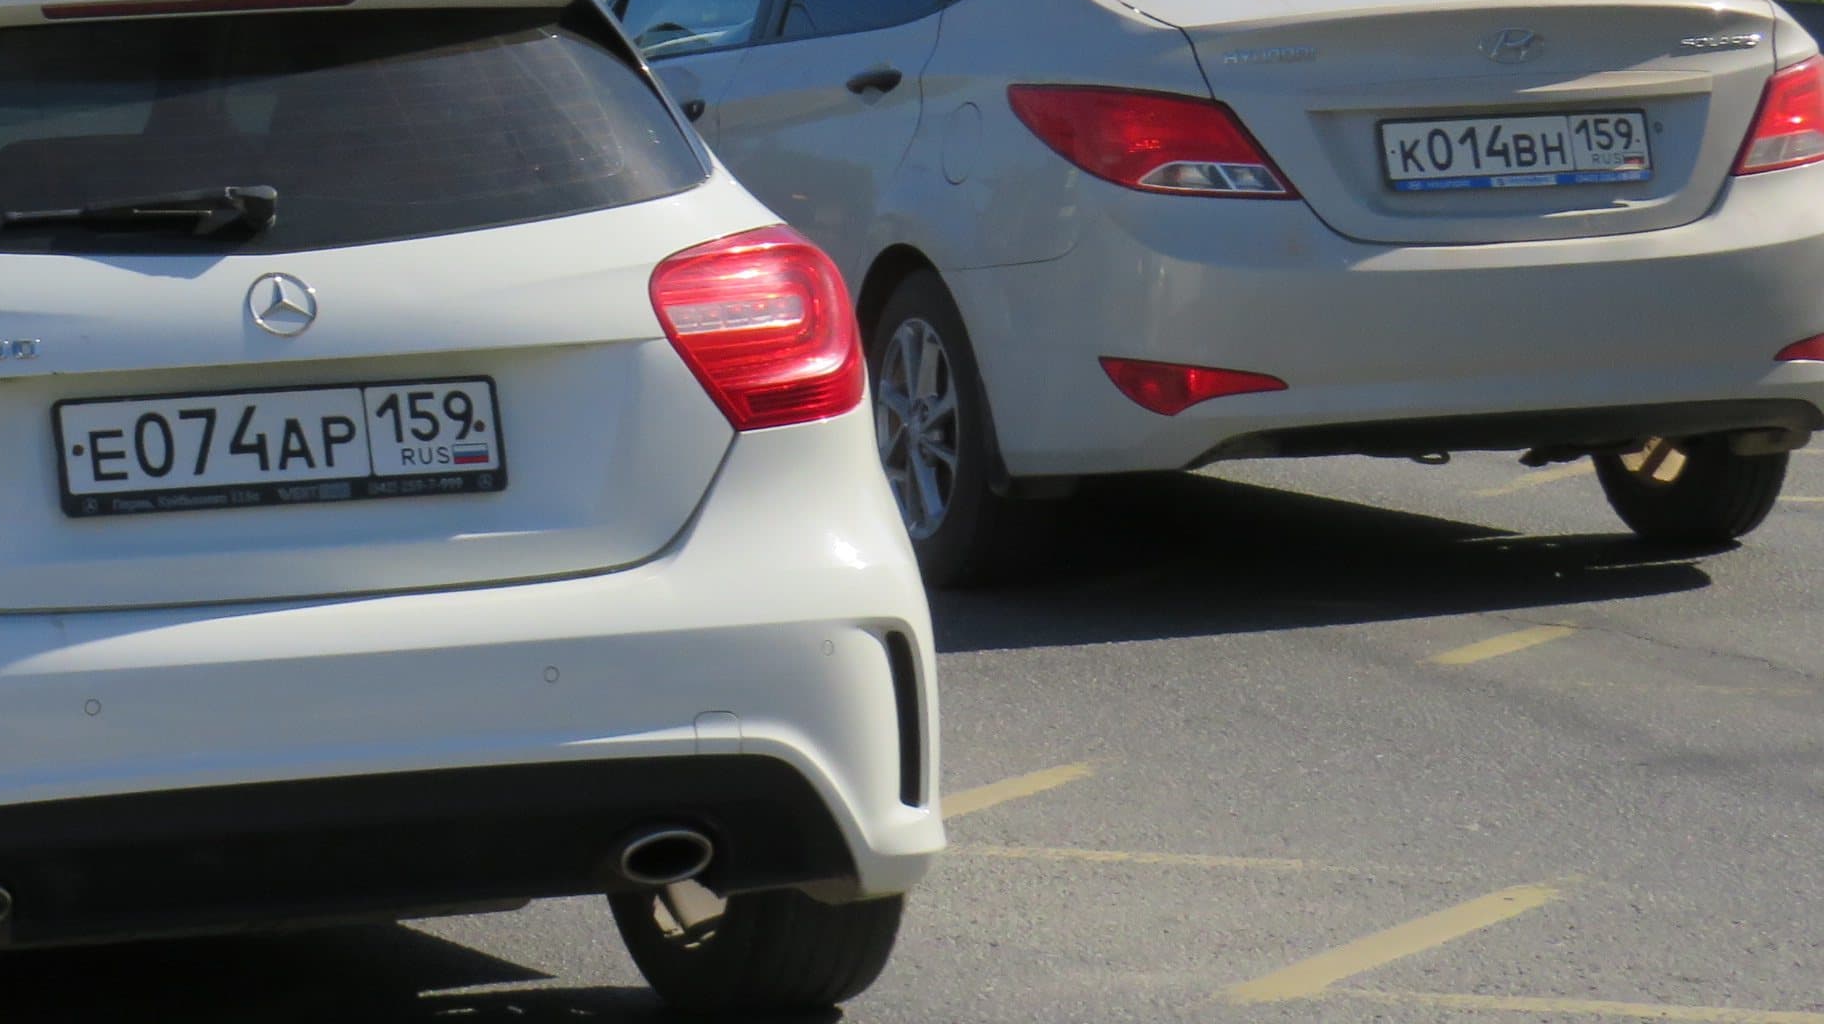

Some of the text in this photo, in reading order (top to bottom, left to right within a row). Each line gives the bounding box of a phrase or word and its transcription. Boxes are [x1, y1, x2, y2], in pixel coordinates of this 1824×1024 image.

[1400, 118, 1634, 173] К014ВН 159
[1591, 153, 1623, 165] RUS
[88, 389, 474, 482] Е074АР 159
[401, 446, 450, 465] RUS
